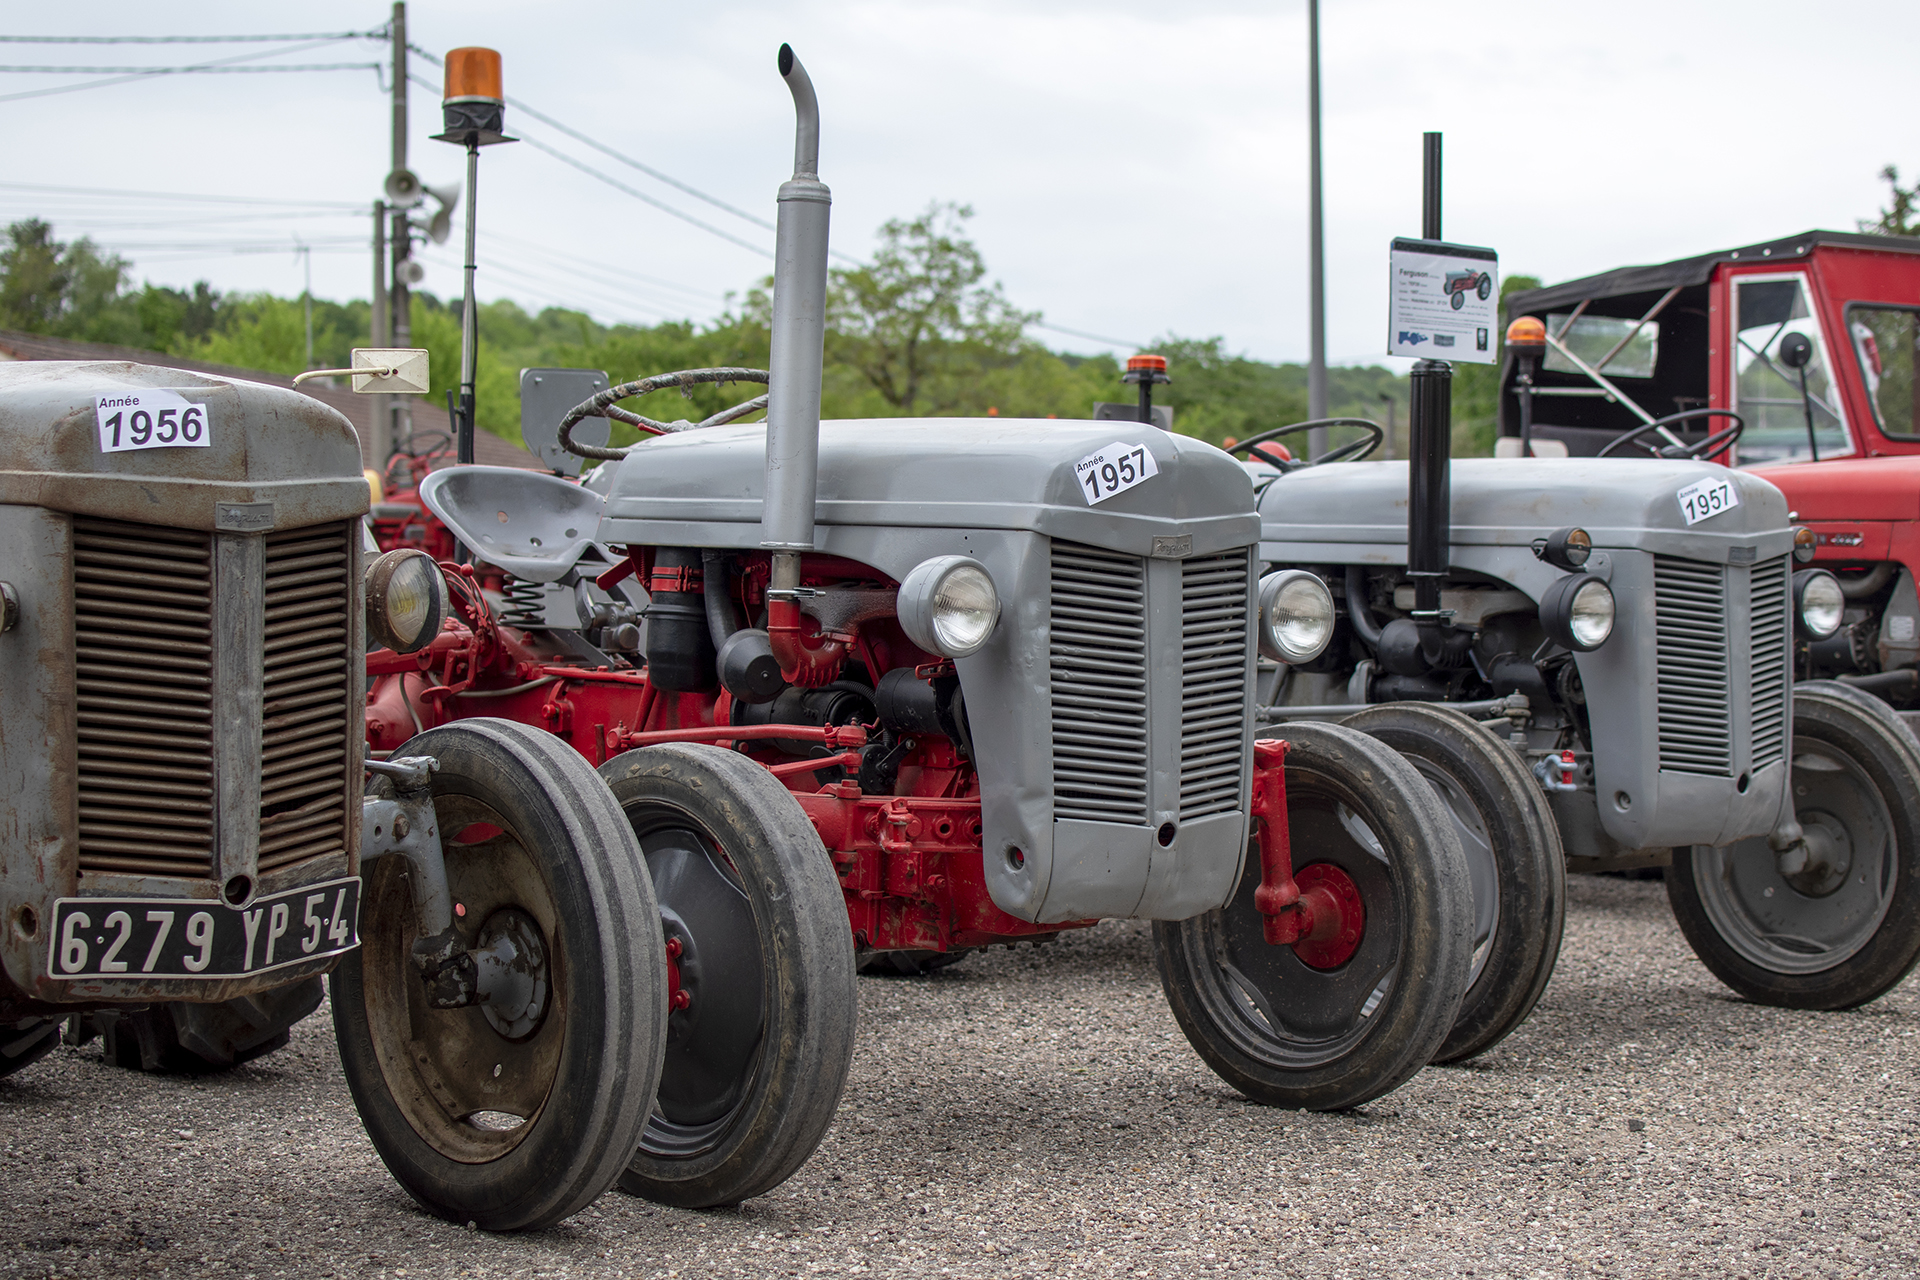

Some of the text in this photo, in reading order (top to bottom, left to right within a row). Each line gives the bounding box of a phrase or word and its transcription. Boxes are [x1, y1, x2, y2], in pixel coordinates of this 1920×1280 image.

[1399, 268, 1428, 279] Ferguson
[99, 395, 140, 408] Année
[105, 408, 202, 447] 1956
[1077, 455, 1104, 473] Année
[1085, 448, 1145, 499] 1957
[1679, 487, 1698, 499] Année
[1686, 484, 1728, 520] 1957
[220, 507, 270, 528] Ferguson
[242, 902, 289, 971] YP
[301, 888, 349, 954] 54
